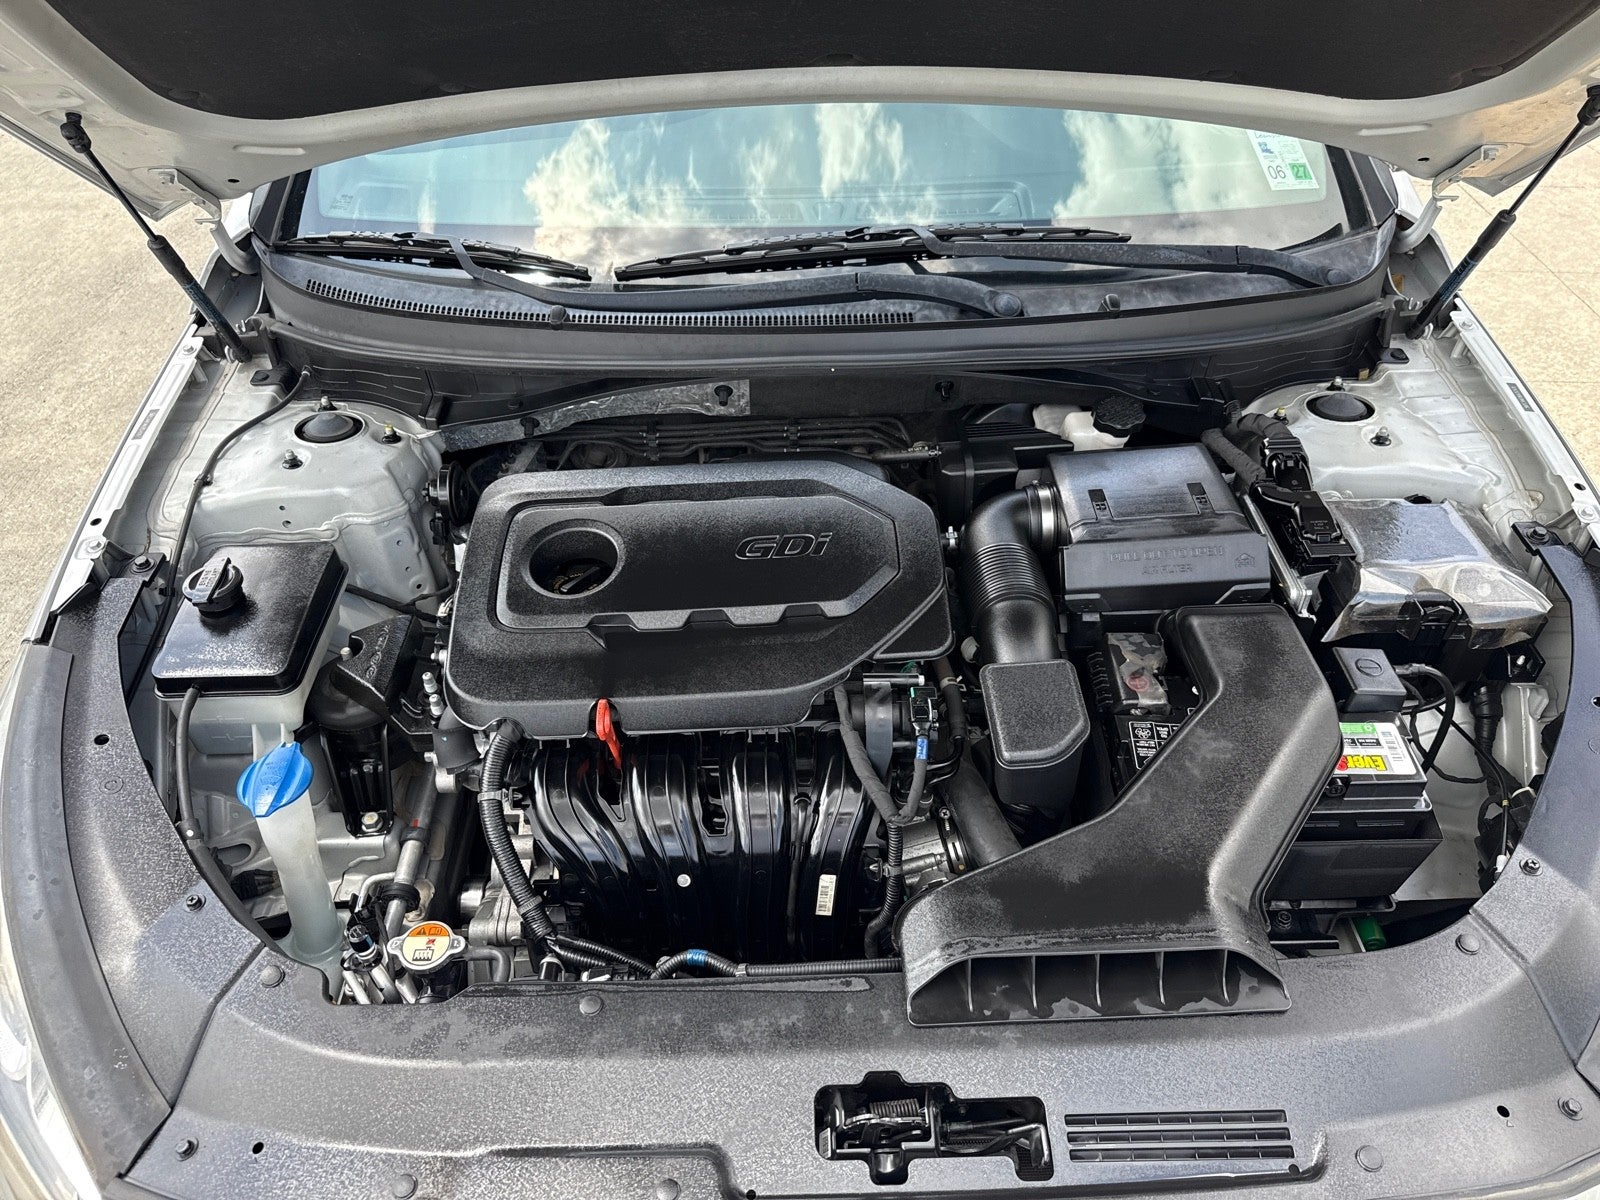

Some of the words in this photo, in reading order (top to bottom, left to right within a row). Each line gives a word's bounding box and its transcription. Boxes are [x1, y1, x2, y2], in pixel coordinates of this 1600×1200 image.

[1268, 165, 1286, 179] 06
[1292, 164, 1308, 179] 27
[735, 532, 832, 560] GDi
